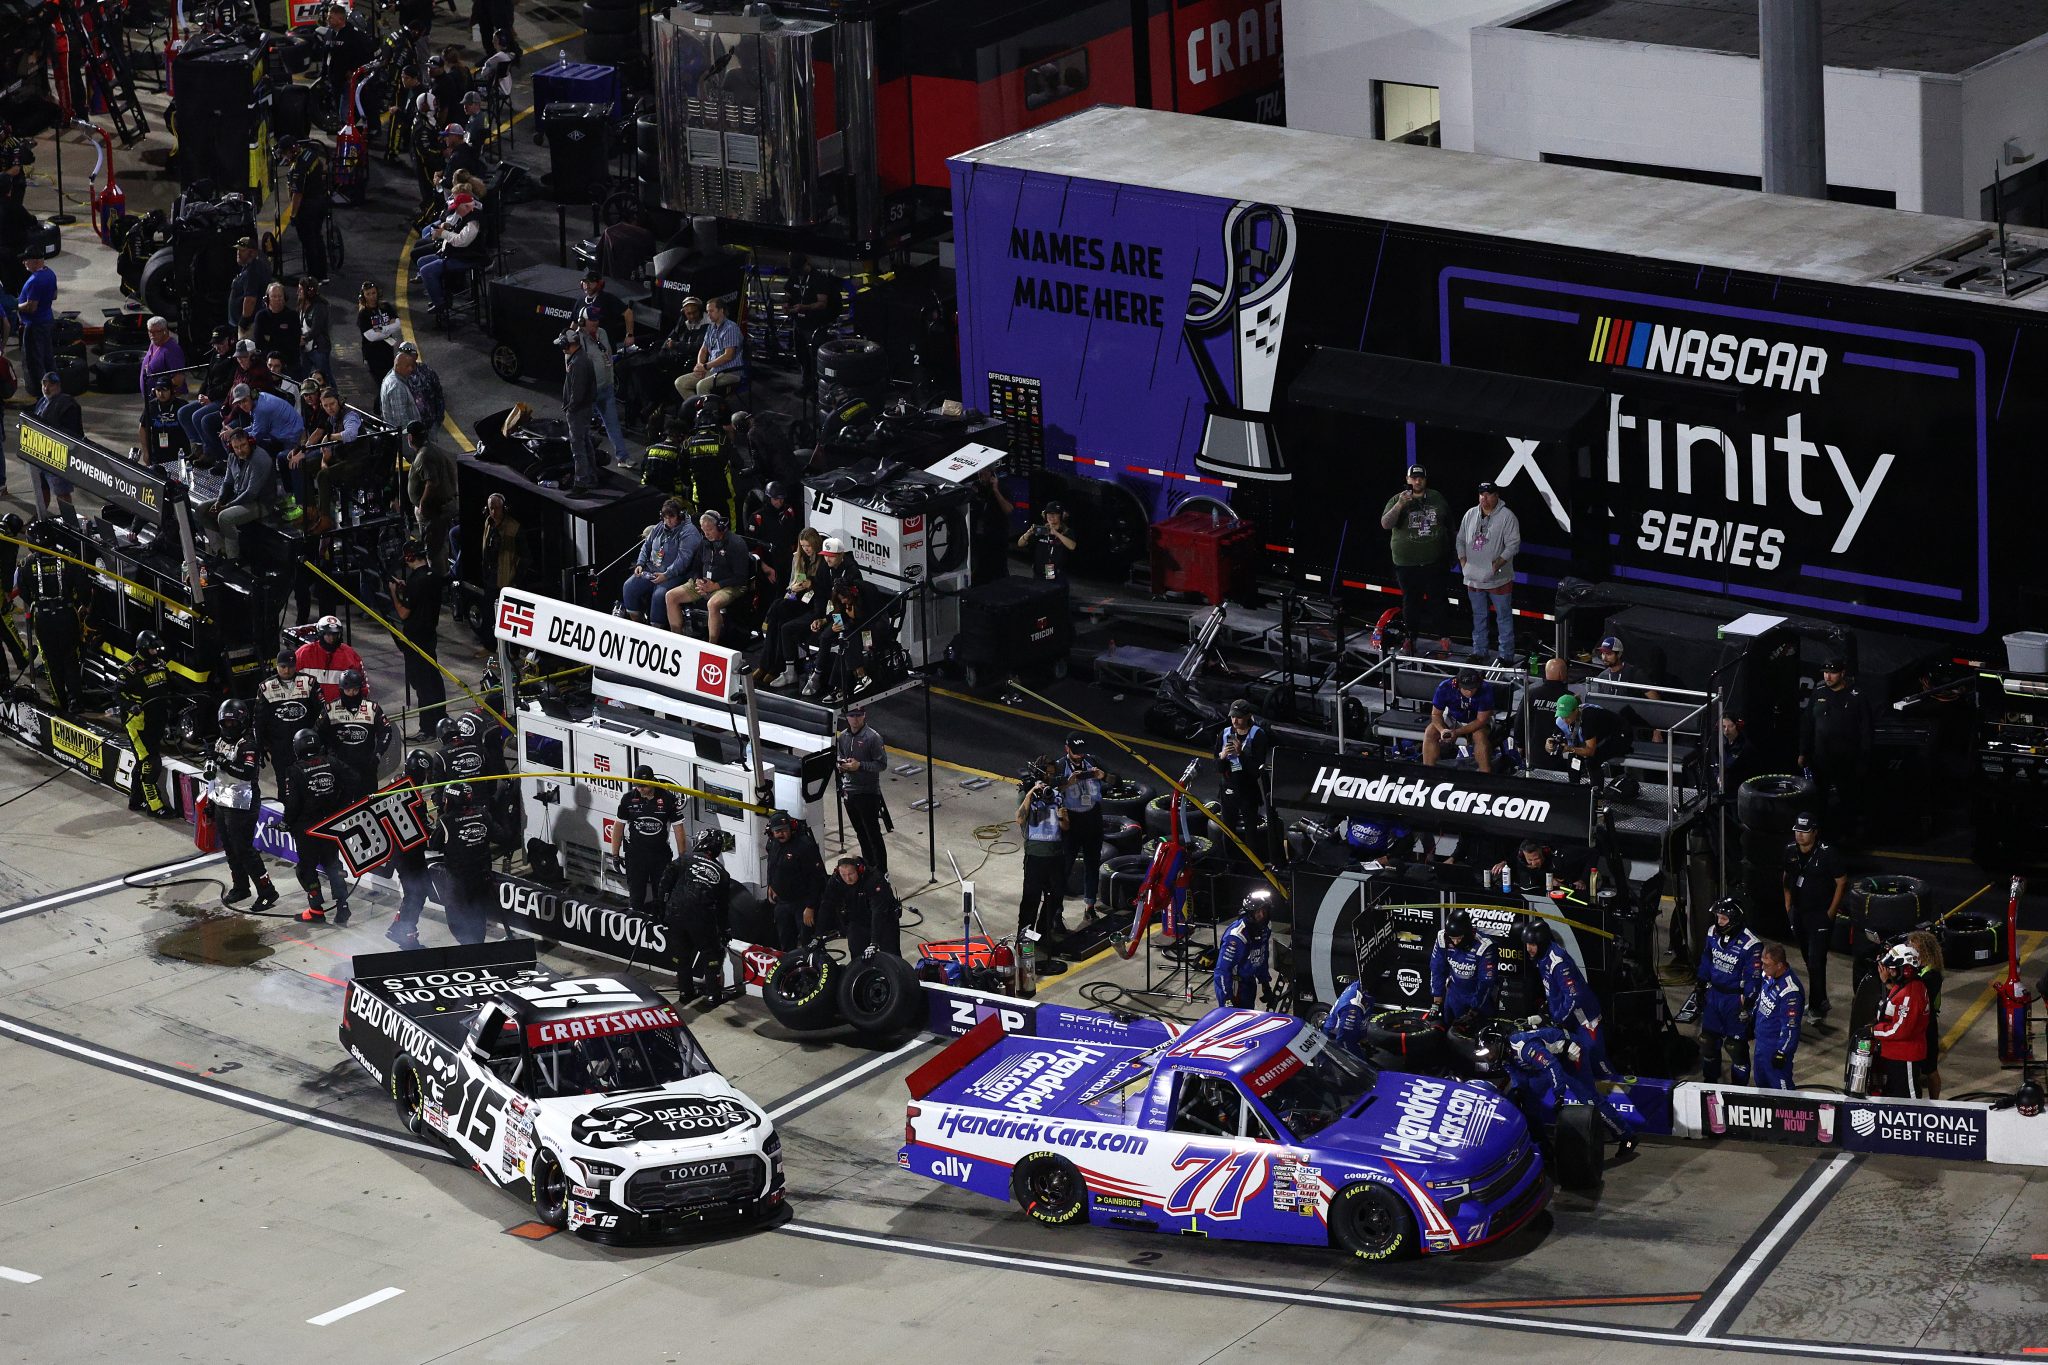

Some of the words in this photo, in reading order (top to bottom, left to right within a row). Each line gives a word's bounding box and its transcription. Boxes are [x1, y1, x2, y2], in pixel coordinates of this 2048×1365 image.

[1012, 226, 1105, 271] NAMES
[1110, 241, 1164, 280] ARE
[662, 279, 691, 293] NASCAR
[545, 306, 572, 319] NASCAR
[1014, 275, 1090, 316] MADE
[1095, 287, 1164, 328] HERE
[1646, 324, 1828, 394] NASCAR
[988, 371, 1011, 383] OFFICIAL
[1012, 375, 1040, 387] SPONSORS
[20, 425, 68, 464] CHAMPION
[70, 456, 113, 487] POWERING
[114, 476, 137, 498] YOUR
[812, 489, 834, 515] 15
[850, 536, 890, 559] TRICON
[903, 540, 923, 550] TRD
[1637, 510, 1786, 571] SERIES
[854, 550, 887, 568] GARAGE
[1030, 627, 1054, 642] TRICON
[548, 616, 597, 652] DEAD
[599, 630, 626, 662] ON
[628, 637, 682, 677] TOOLS
[54, 721, 101, 757] CHAMPION
[582, 771, 624, 793] TRICON
[586, 785, 620, 800] GARAGE
[254, 816, 298, 853] xfin
[500, 881, 557, 922] DEAD
[562, 899, 598, 933] ON
[598, 909, 669, 953] TOOLS
[1464, 906, 1516, 923] Hendrick
[1471, 919, 1512, 931] Cars.com
[383, 969, 500, 990] TOOLS
[766, 960, 782, 984] EAGLE
[1397, 974, 1422, 984] Nations
[438, 980, 511, 1000] DEAD
[1399, 980, 1420, 989] Guard
[394, 989, 438, 1006] ON
[350, 986, 383, 1028] DEAD
[382, 1010, 399, 1042] ON
[399, 1021, 435, 1066] TOOLS
[539, 1008, 670, 1042] CRAFTSMAN
[1060, 1012, 1128, 1031] SPIRE
[350, 1044, 383, 1084] SiriusXM
[1254, 1055, 1298, 1087] CRAFTSMAN
[980, 1051, 1052, 1103] Cars.com
[1004, 1045, 1106, 1112] Hendrick
[1078, 1061, 1131, 1102] CHEVROLET
[424, 1108, 442, 1129] TRD
[456, 1078, 508, 1153] 15
[653, 1105, 704, 1122] DEAD
[703, 1101, 735, 1117] ON
[662, 1112, 744, 1132] TOOLS
[1381, 1078, 1446, 1158] Hendrick
[1429, 1088, 1477, 1148] Cars.com
[1728, 1105, 1773, 1129] NEW!
[1775, 1108, 1814, 1121] AVAILABLE
[1878, 1109, 1979, 1132] NATIONAL
[1784, 1119, 1806, 1132] NOW
[1881, 1126, 1920, 1141] DEBT
[1926, 1131, 1977, 1146] RELIEF
[1029, 1150, 1055, 1162] EAGLE
[669, 1162, 728, 1180] TOYOTA
[931, 1156, 973, 1183] ally
[1166, 1142, 1270, 1217] 71
[1299, 1167, 1321, 1175] SKF
[1344, 1172, 1395, 1185] GOODYEAR
[573, 1186, 595, 1197] SIMPSON
[1103, 1196, 1141, 1208] GAINBRIDGE
[1345, 1184, 1371, 1199] EAGLE
[674, 1201, 729, 1212] TUNDRA
[1032, 1201, 1082, 1224] GOODYEAR
[599, 1214, 619, 1228] 15
[1466, 1221, 1487, 1243] 71
[1354, 1233, 1403, 1260] GOODYEAR
[1128, 1251, 1163, 1266] 2
